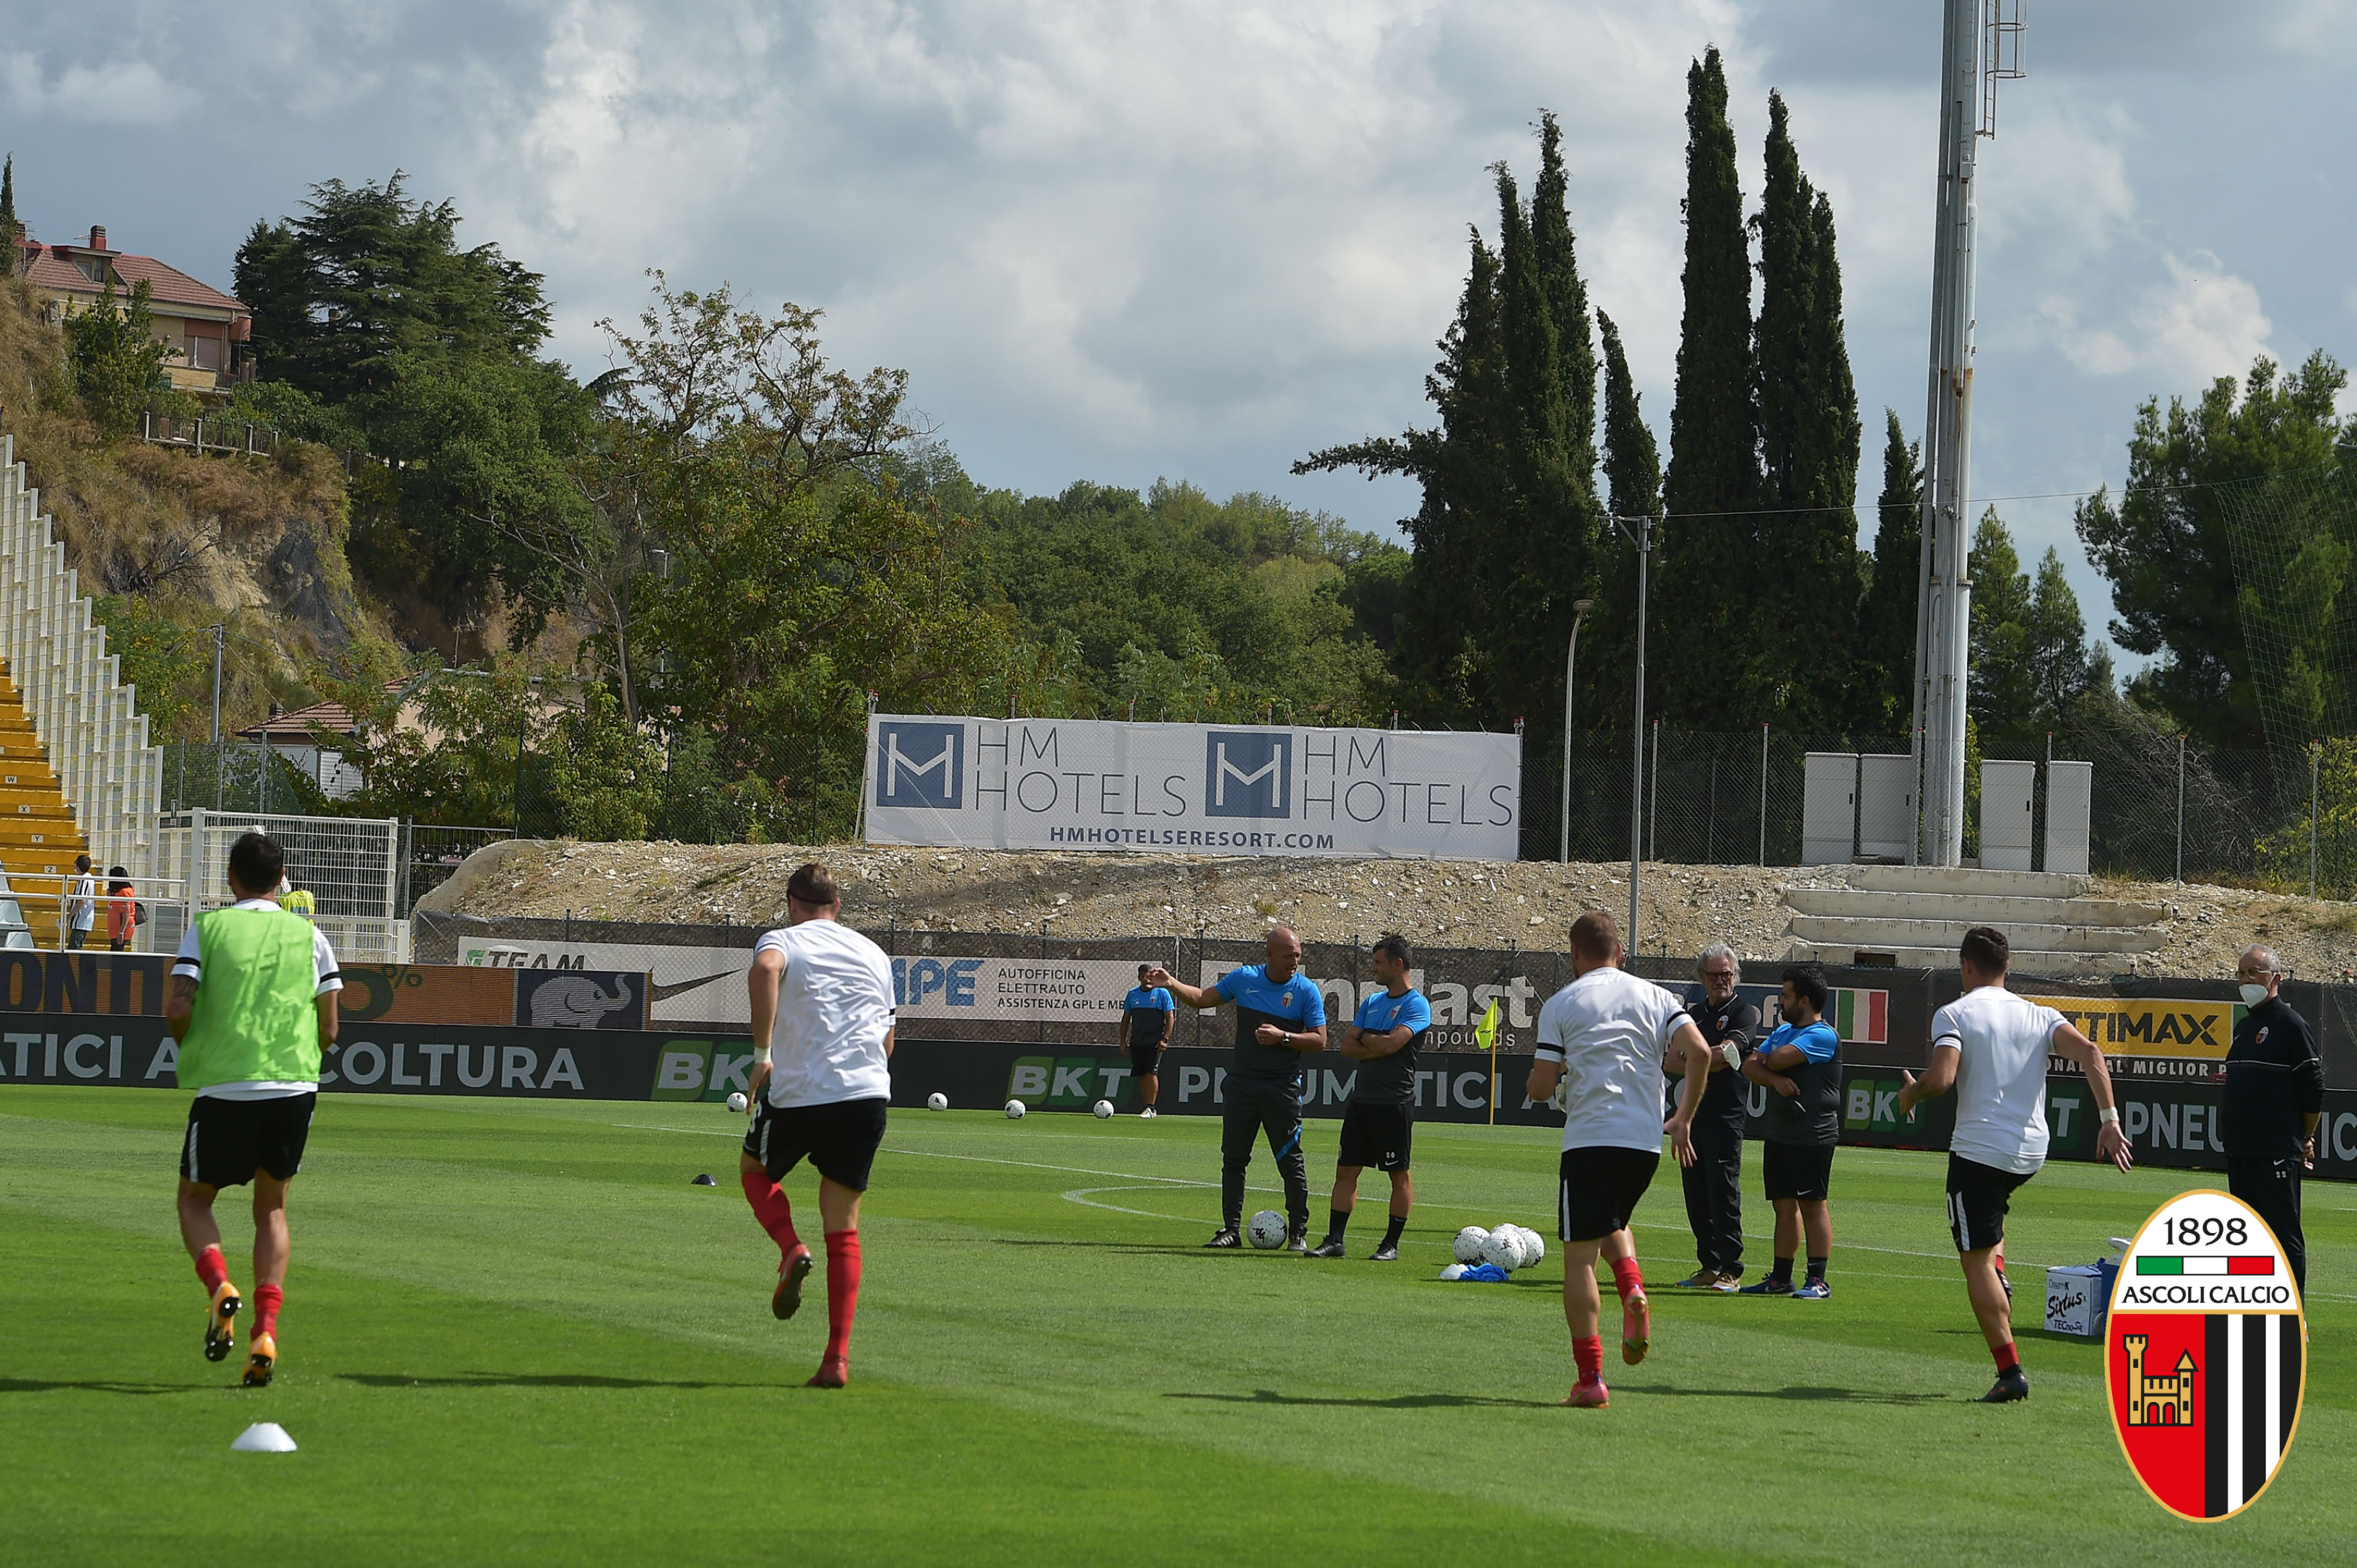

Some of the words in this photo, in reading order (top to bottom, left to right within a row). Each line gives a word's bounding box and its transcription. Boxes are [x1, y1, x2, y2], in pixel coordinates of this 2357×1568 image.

[977, 725, 1059, 767] HM
[1305, 734, 1386, 778] HM
[976, 770, 1187, 817] HOTELS
[1303, 780, 1513, 827] HOTELS
[1050, 827, 1334, 850] HMHOTELSERESORT.COM
[998, 968, 1086, 980] AUTOFFICINA
[998, 983, 1085, 995] ELETTRAUTO
[997, 998, 1069, 1009] ASSISTENZA
[1072, 1000, 1095, 1009] GPL
[1098, 1000, 1105, 1009] E
[2132, 1060, 2209, 1076] MIGLIOR
[1012, 1066, 1132, 1098] BKT
